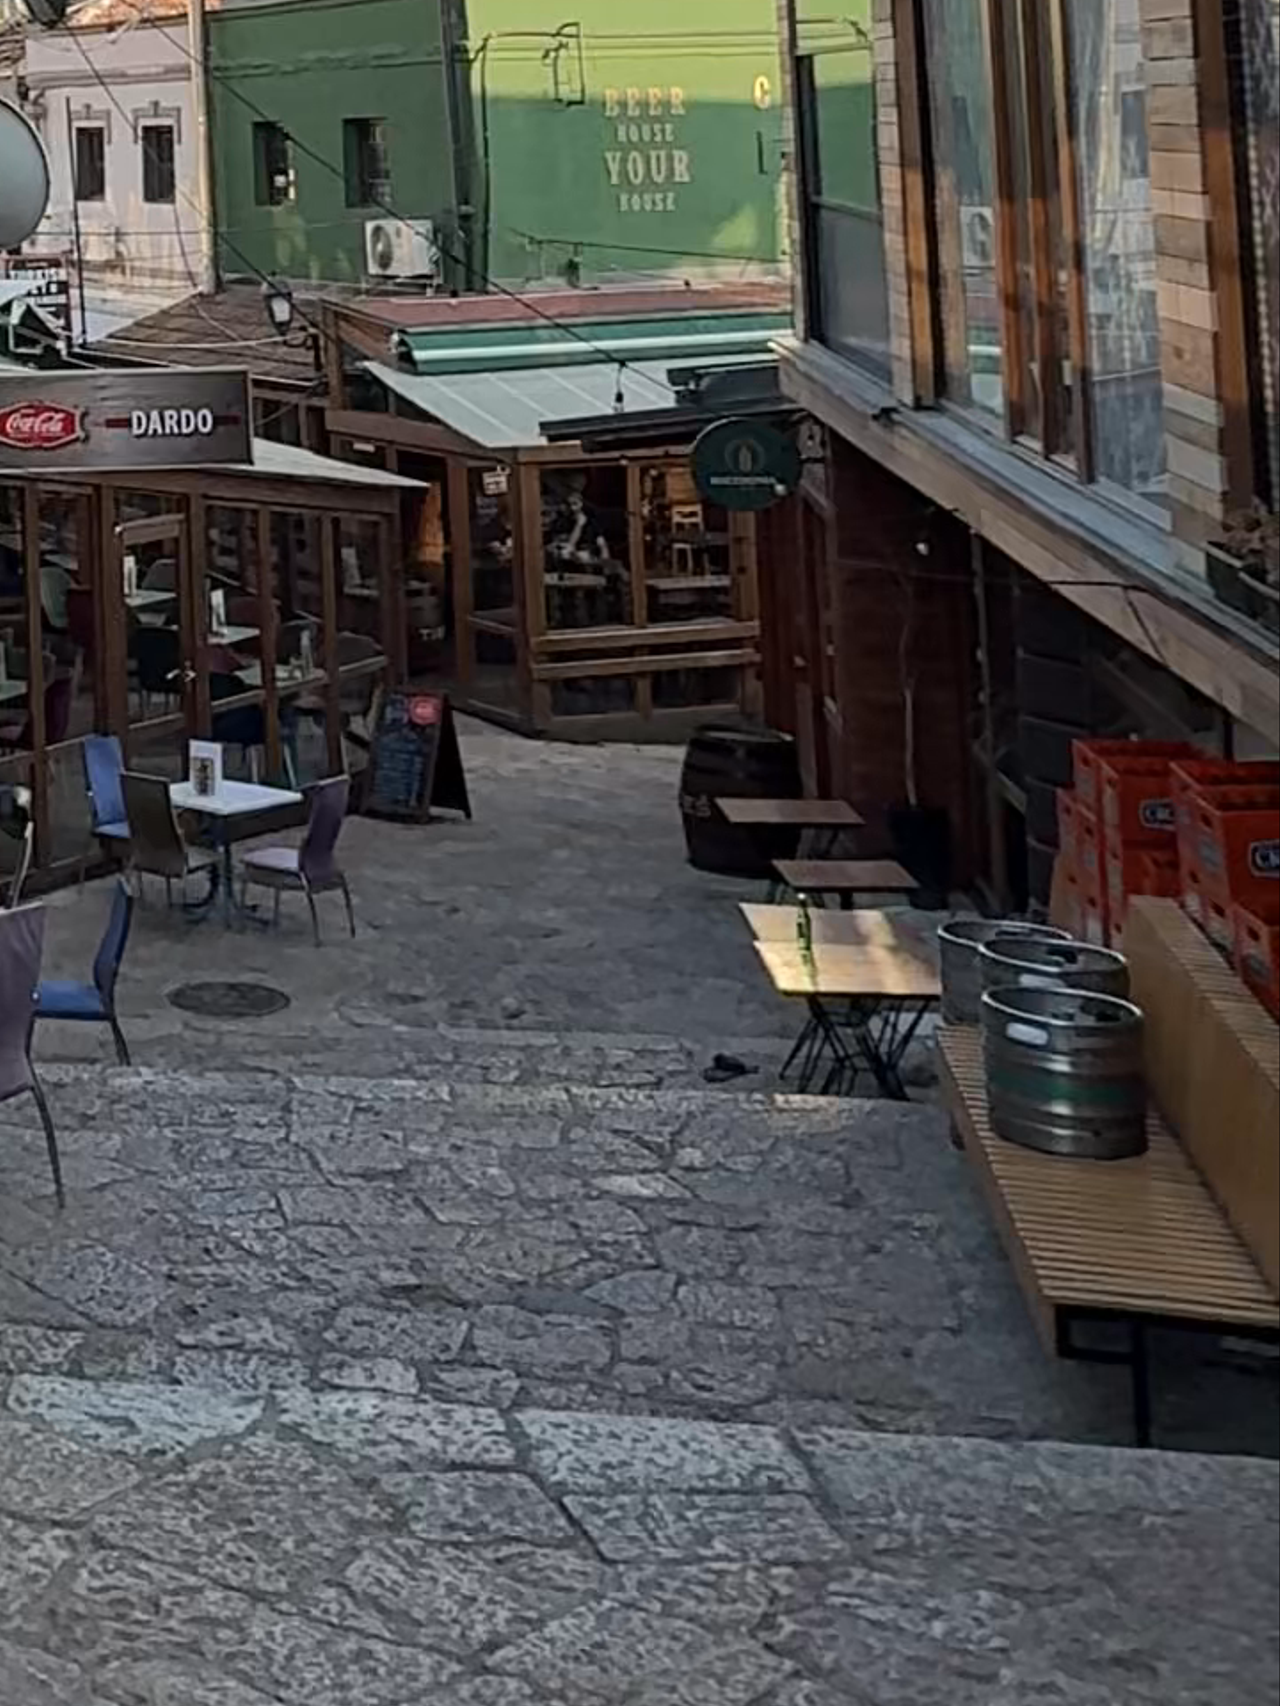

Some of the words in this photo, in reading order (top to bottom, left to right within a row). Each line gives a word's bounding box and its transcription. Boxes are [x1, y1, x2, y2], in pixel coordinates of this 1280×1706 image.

[604, 86, 686, 118] BEER
[617, 123, 675, 143] HOUSE
[604, 149, 690, 186] YOUR
[619, 192, 676, 212] HOUSE
[131, 408, 214, 436] DARDO
